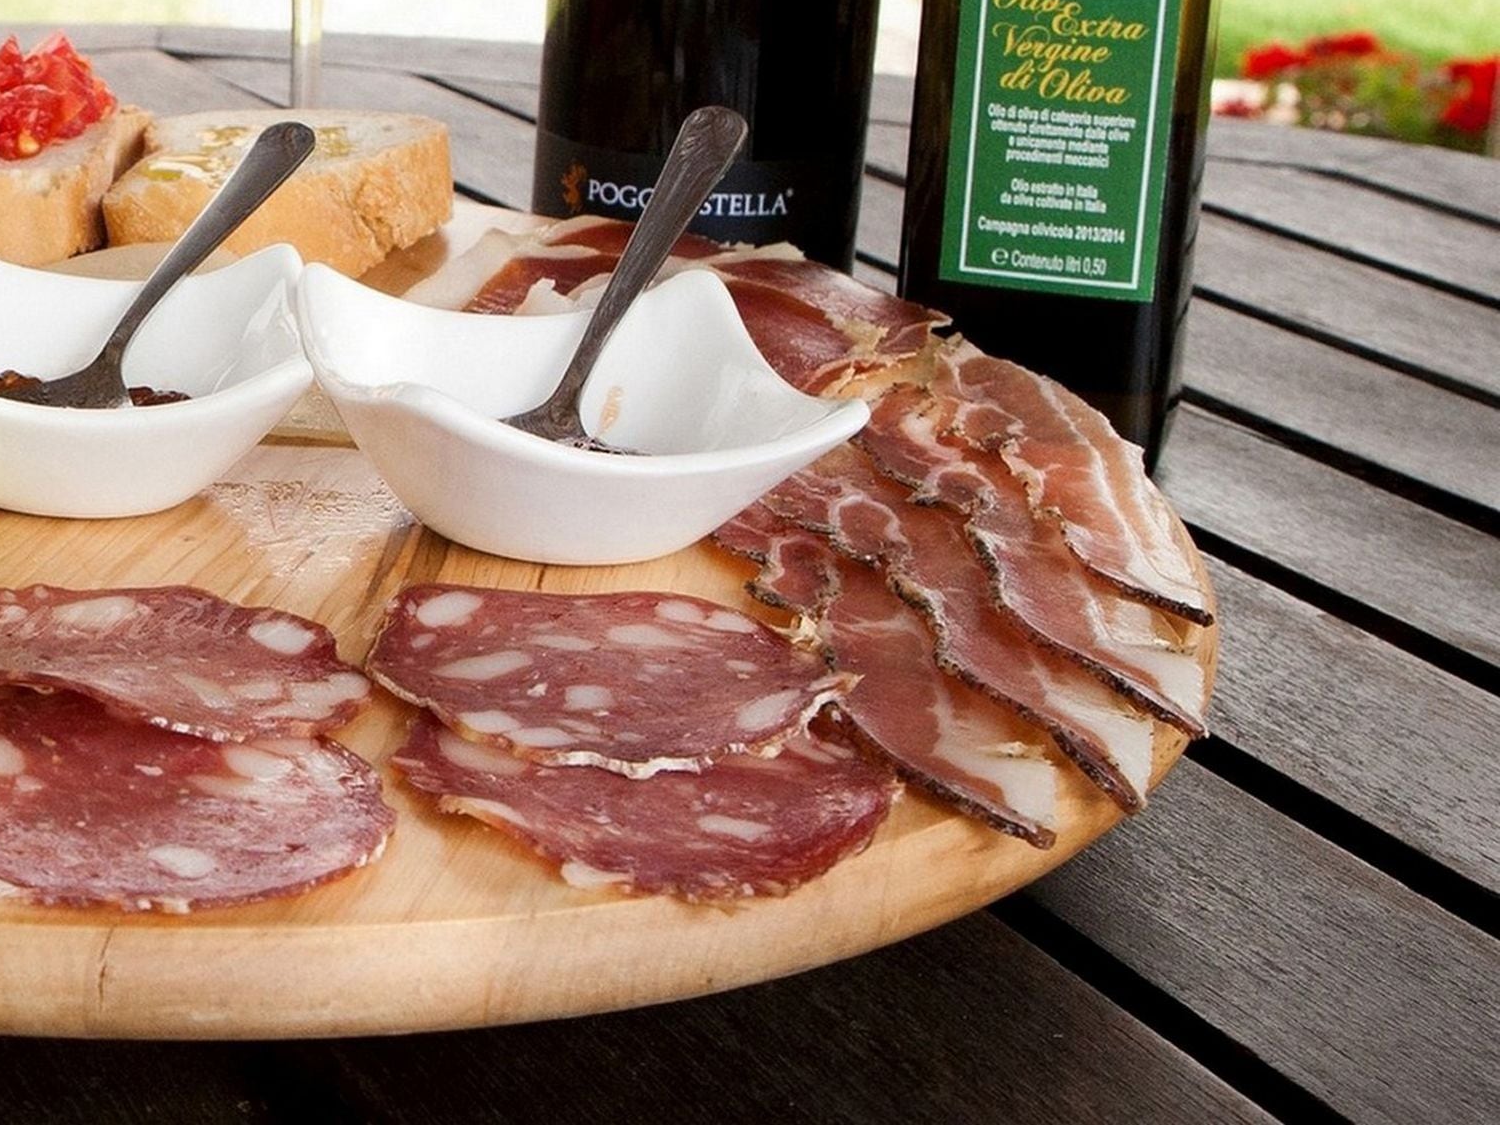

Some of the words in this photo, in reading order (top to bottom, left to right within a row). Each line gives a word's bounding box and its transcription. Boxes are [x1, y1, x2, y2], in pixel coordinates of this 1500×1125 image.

[1036, 2, 1149, 40] Extra
[993, 22, 1112, 72] Vergine
[1000, 59, 1037, 91] di
[1039, 68, 1132, 104] Oliva
[987, 103, 1006, 118] Olio
[1007, 105, 1016, 119] di
[1018, 106, 1039, 121] oliva
[1040, 108, 1049, 122] di
[1051, 110, 1092, 126] categoria
[1093, 114, 1136, 129] superiore
[1016, 136, 1067, 151] unicamente
[1068, 140, 1109, 154] mediante
[1005, 149, 1063, 164] procedimenti
[1064, 153, 1109, 168] meccanici
[1011, 177, 1029, 193] Olio
[1031, 181, 1065, 196] estratto
[1066, 183, 1075, 197] in
[1076, 184, 1098, 200] Italia
[1000, 191, 1012, 205] da
[1074, 198, 1083, 212] in
[1084, 198, 1107, 214] Italia
[977, 215, 1030, 238] Campagna
[1031, 221, 1073, 239] olivicola
[1075, 225, 1126, 244] 2013/2014
[1011, 250, 1064, 272] Contenuto
[1065, 254, 1081, 273] litri
[1083, 256, 1107, 276] 0,50
